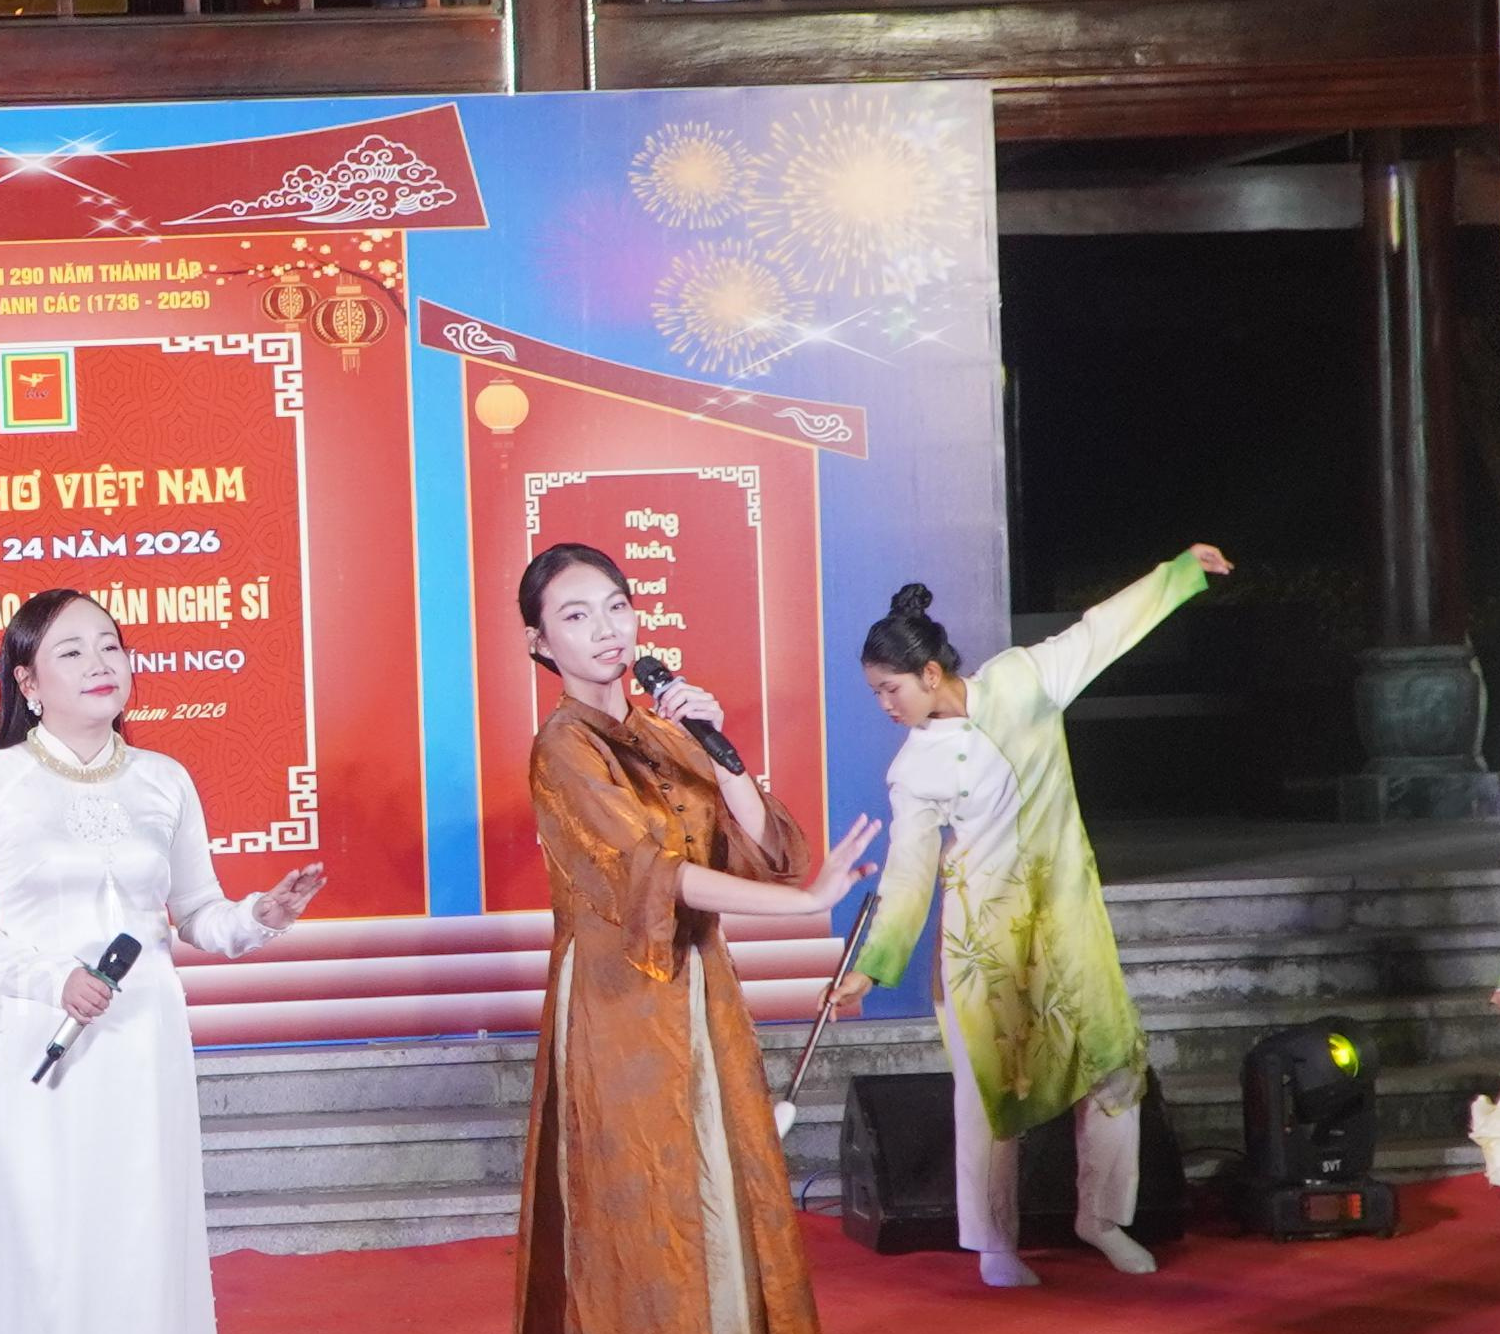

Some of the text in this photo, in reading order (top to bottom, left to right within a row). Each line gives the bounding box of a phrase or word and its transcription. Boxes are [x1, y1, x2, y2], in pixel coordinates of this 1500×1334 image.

[10, 267, 44, 286] 290
[50, 261, 94, 285] NĂM
[99, 260, 161, 283] THÀNH
[166, 258, 202, 281] LẬP
[0, 296, 38, 315] ANH
[43, 291, 80, 313] CÁC
[88, 294, 139, 314] (1736
[158, 290, 211, 310] 2026)
[53, 463, 144, 515] VIỆT
[158, 465, 246, 505] NAM
[3, 537, 44, 562] 24
[52, 530, 126, 560] NĂM
[135, 530, 221, 556] 2026
[625, 541, 676, 562] Xuân
[157, 577, 232, 629] NGHỆ
[242, 576, 271, 621] SĨ
[130, 649, 176, 673] ÍNH
[183, 649, 245, 675] NGỌ
[124, 706, 169, 723] năm
[172, 702, 227, 720] 2026
[1322, 1159, 1343, 1173] SVT
